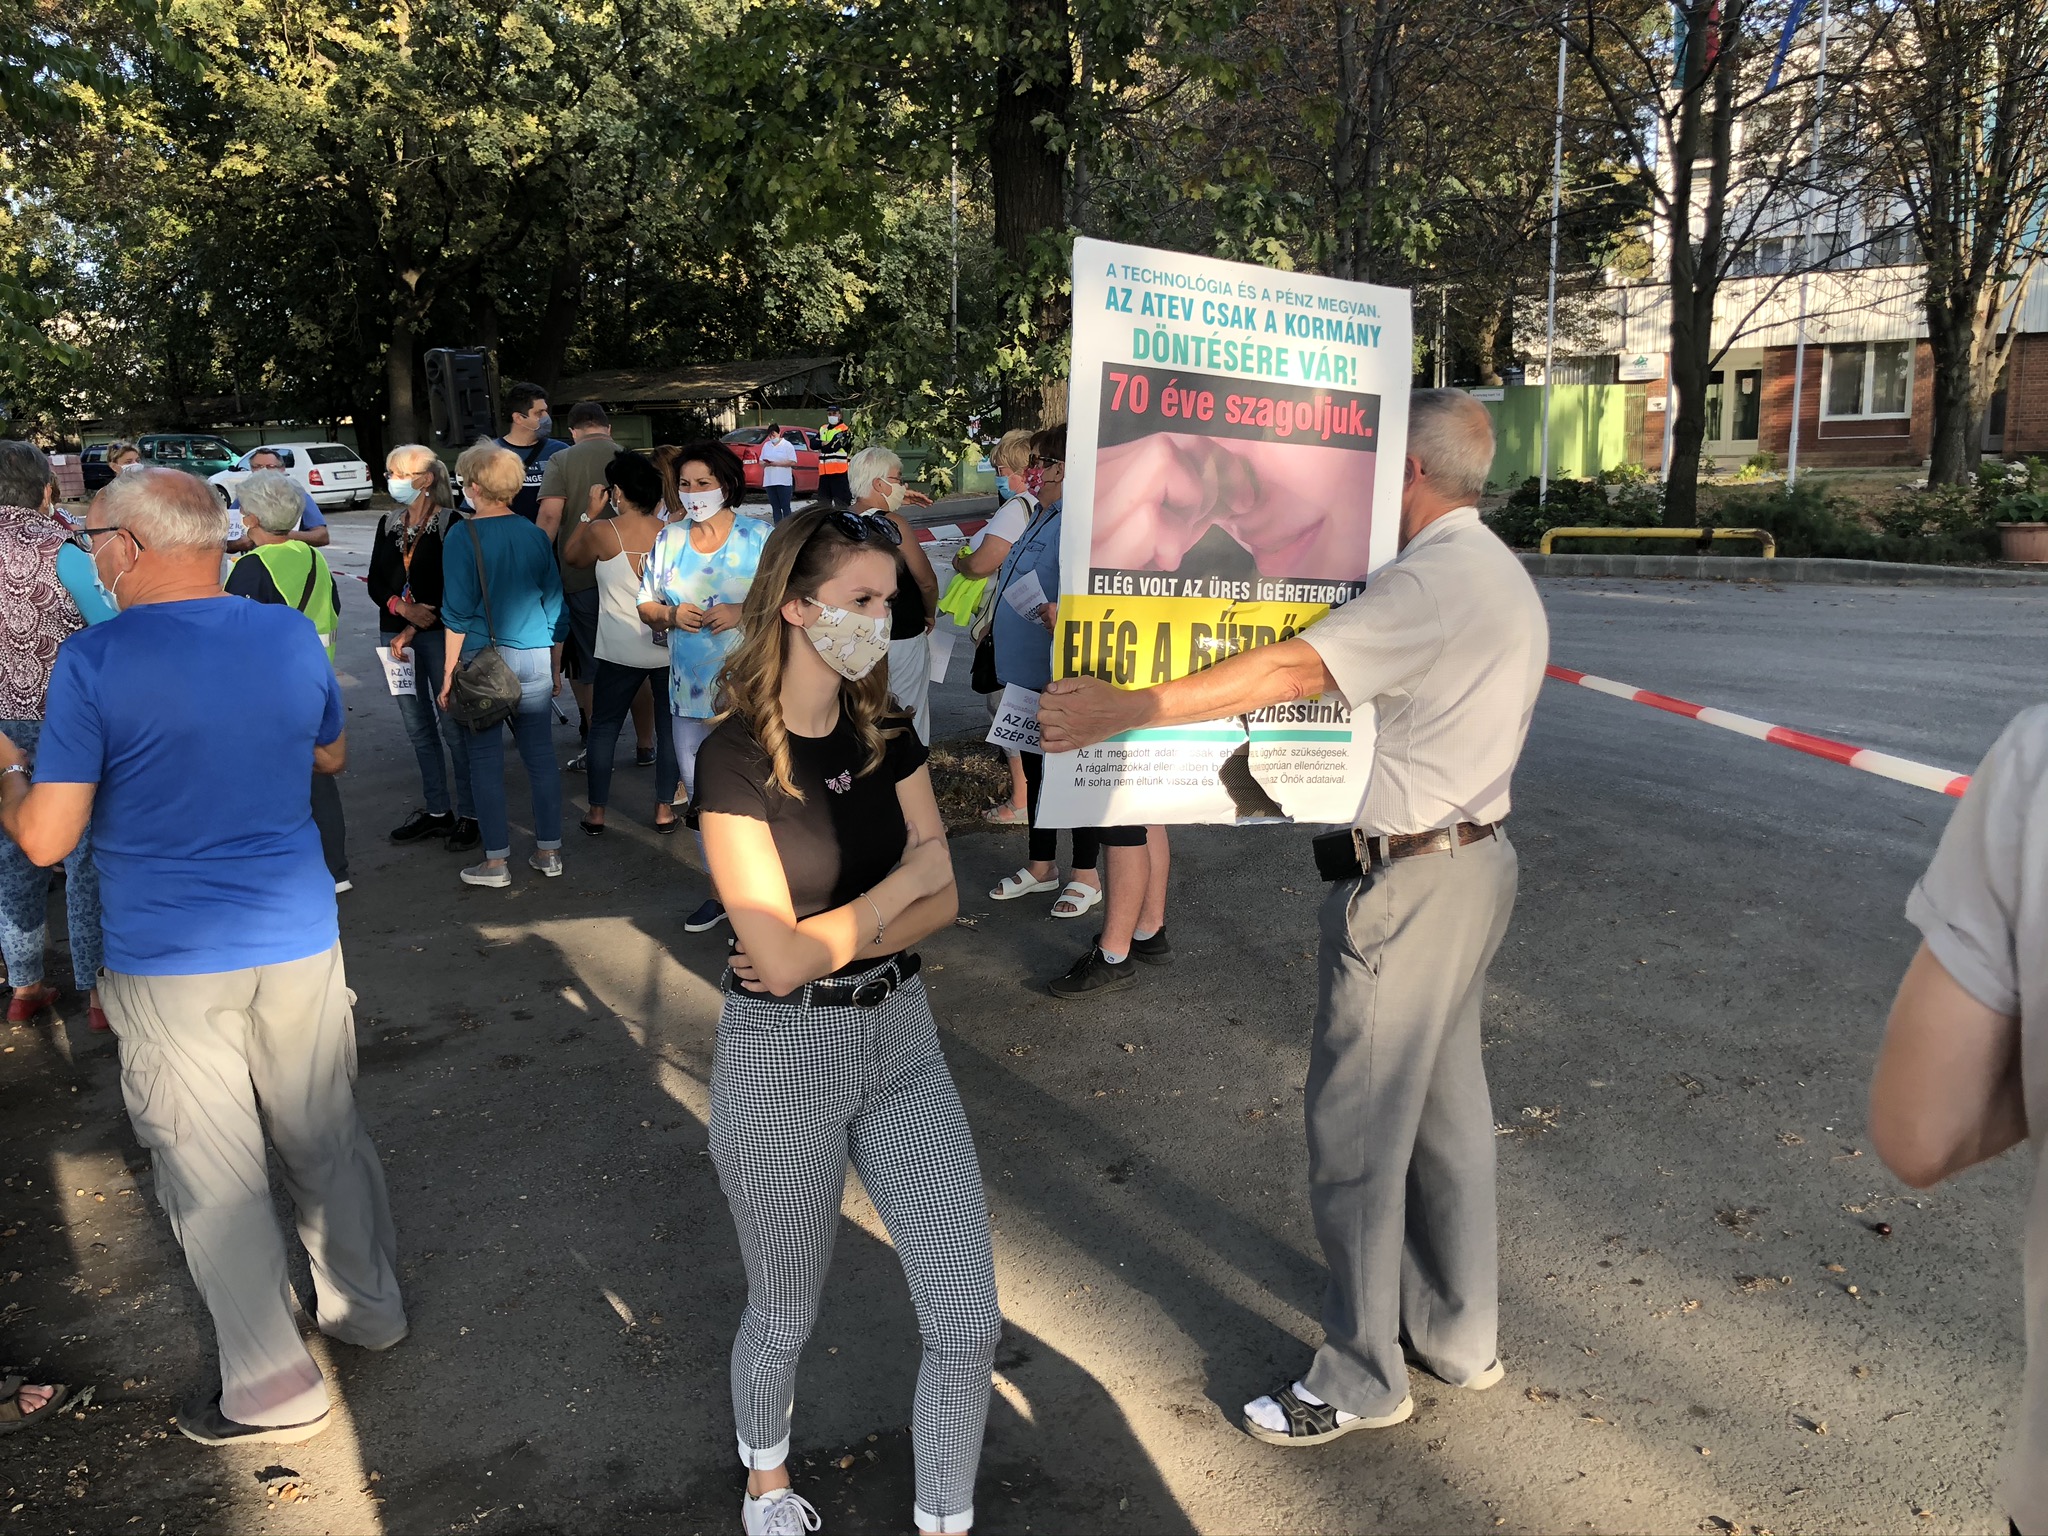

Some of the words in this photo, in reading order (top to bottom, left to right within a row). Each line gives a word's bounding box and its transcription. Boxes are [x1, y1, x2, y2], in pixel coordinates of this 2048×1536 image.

[1106, 263, 1117, 278] A
[1121, 265, 1233, 296] TECHNOLÓGIA
[1238, 280, 1257, 300] ÉS
[1261, 288, 1271, 302] A
[1276, 288, 1313, 309] PÉNZ
[1318, 297, 1381, 319] MEGVAN.
[1105, 286, 1133, 314] AZ
[1140, 291, 1194, 322] ATEV
[1202, 300, 1257, 331] CSAK
[1264, 310, 1278, 334] A
[1284, 313, 1382, 348] KORMÁNY
[1132, 323, 1289, 377] DÖNTÉSÉRE
[1298, 345, 1357, 386] VÁR!
[1109, 372, 1149, 414] 70
[1161, 379, 1215, 421] éve
[1224, 393, 1373, 440] szagoljuk.
[1093, 571, 1133, 595] ELÉG
[1139, 577, 1178, 597] VOLT
[1181, 579, 1203, 598] AZ
[1208, 576, 1250, 600] ÜRES
[1063, 609, 1138, 684] ELÉG
[1150, 622, 1172, 683] A
[993, 726, 1025, 742] SZÉP
[1002, 713, 1022, 727] AZ
[1076, 763, 1083, 772] A
[1085, 763, 1151, 775] rágalmazókkal
[1294, 761, 1348, 771] ellenőriznek.
[1077, 749, 1089, 759] Az
[1094, 749, 1103, 758] itt
[1107, 748, 1150, 760] megadott
[1291, 747, 1349, 759] szükségesek.
[1074, 777, 1086, 787] Mi
[1088, 778, 1111, 787] soha
[1113, 778, 1134, 787] nem
[1201, 774, 1214, 786] és
[1280, 774, 1304, 784] Önök
[1306, 773, 1346, 784] adataival.
